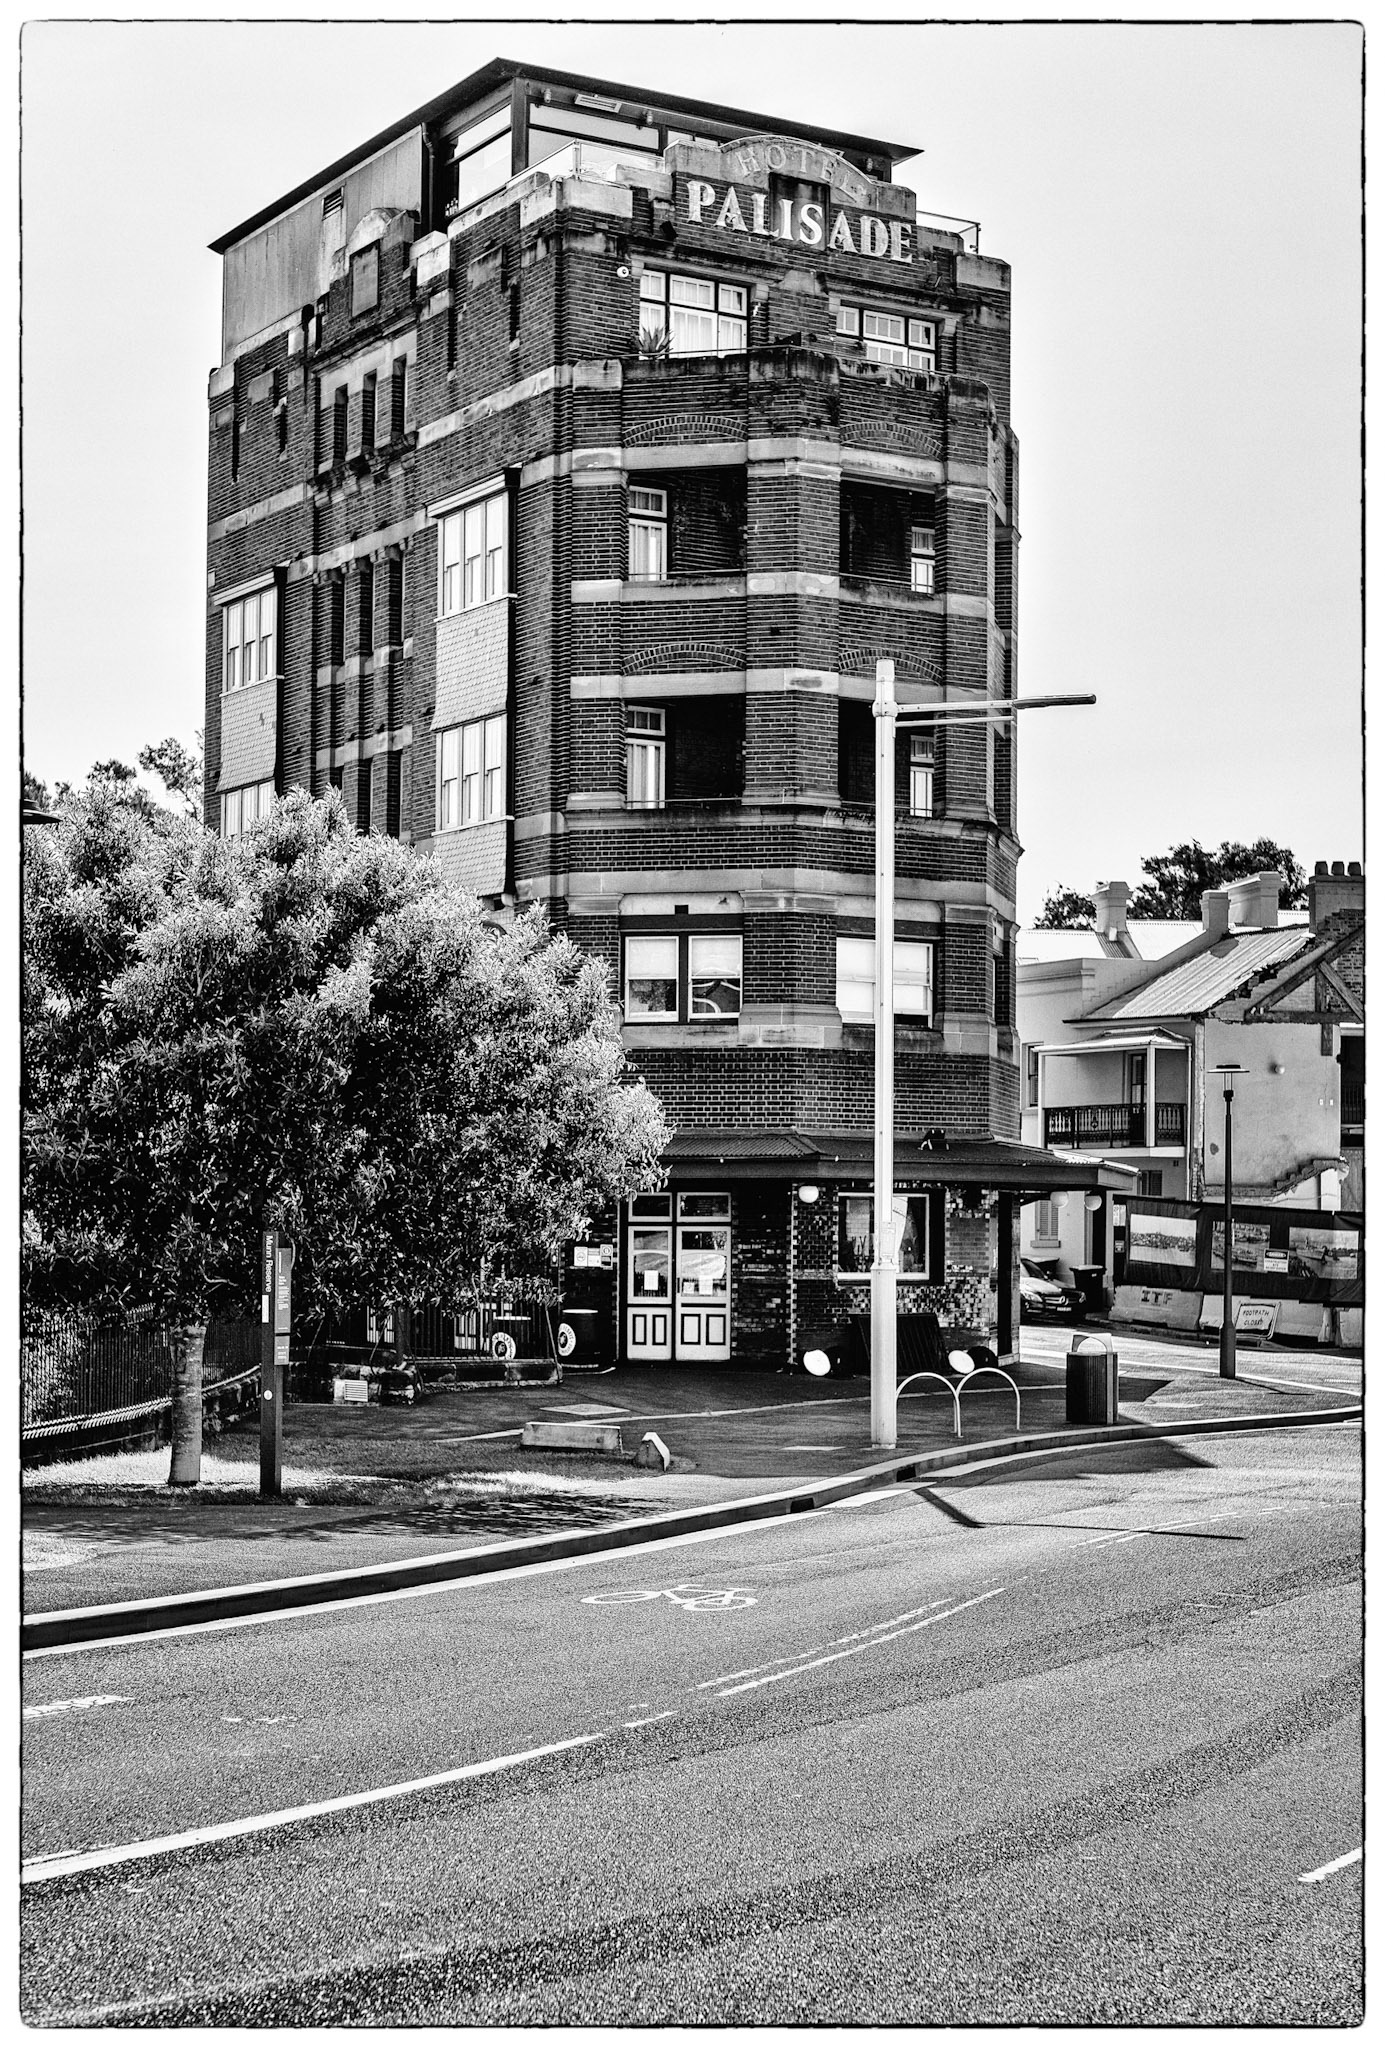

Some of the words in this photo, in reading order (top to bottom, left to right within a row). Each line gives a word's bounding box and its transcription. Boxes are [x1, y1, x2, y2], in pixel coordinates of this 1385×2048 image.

[735, 144, 858, 203] HOTEL
[686, 180, 913, 263] PALISADE
[265, 1235, 274, 1258] Munn
[265, 1259, 274, 1293] Reserve
[1242, 1309, 1270, 1317] FOOTPATH
